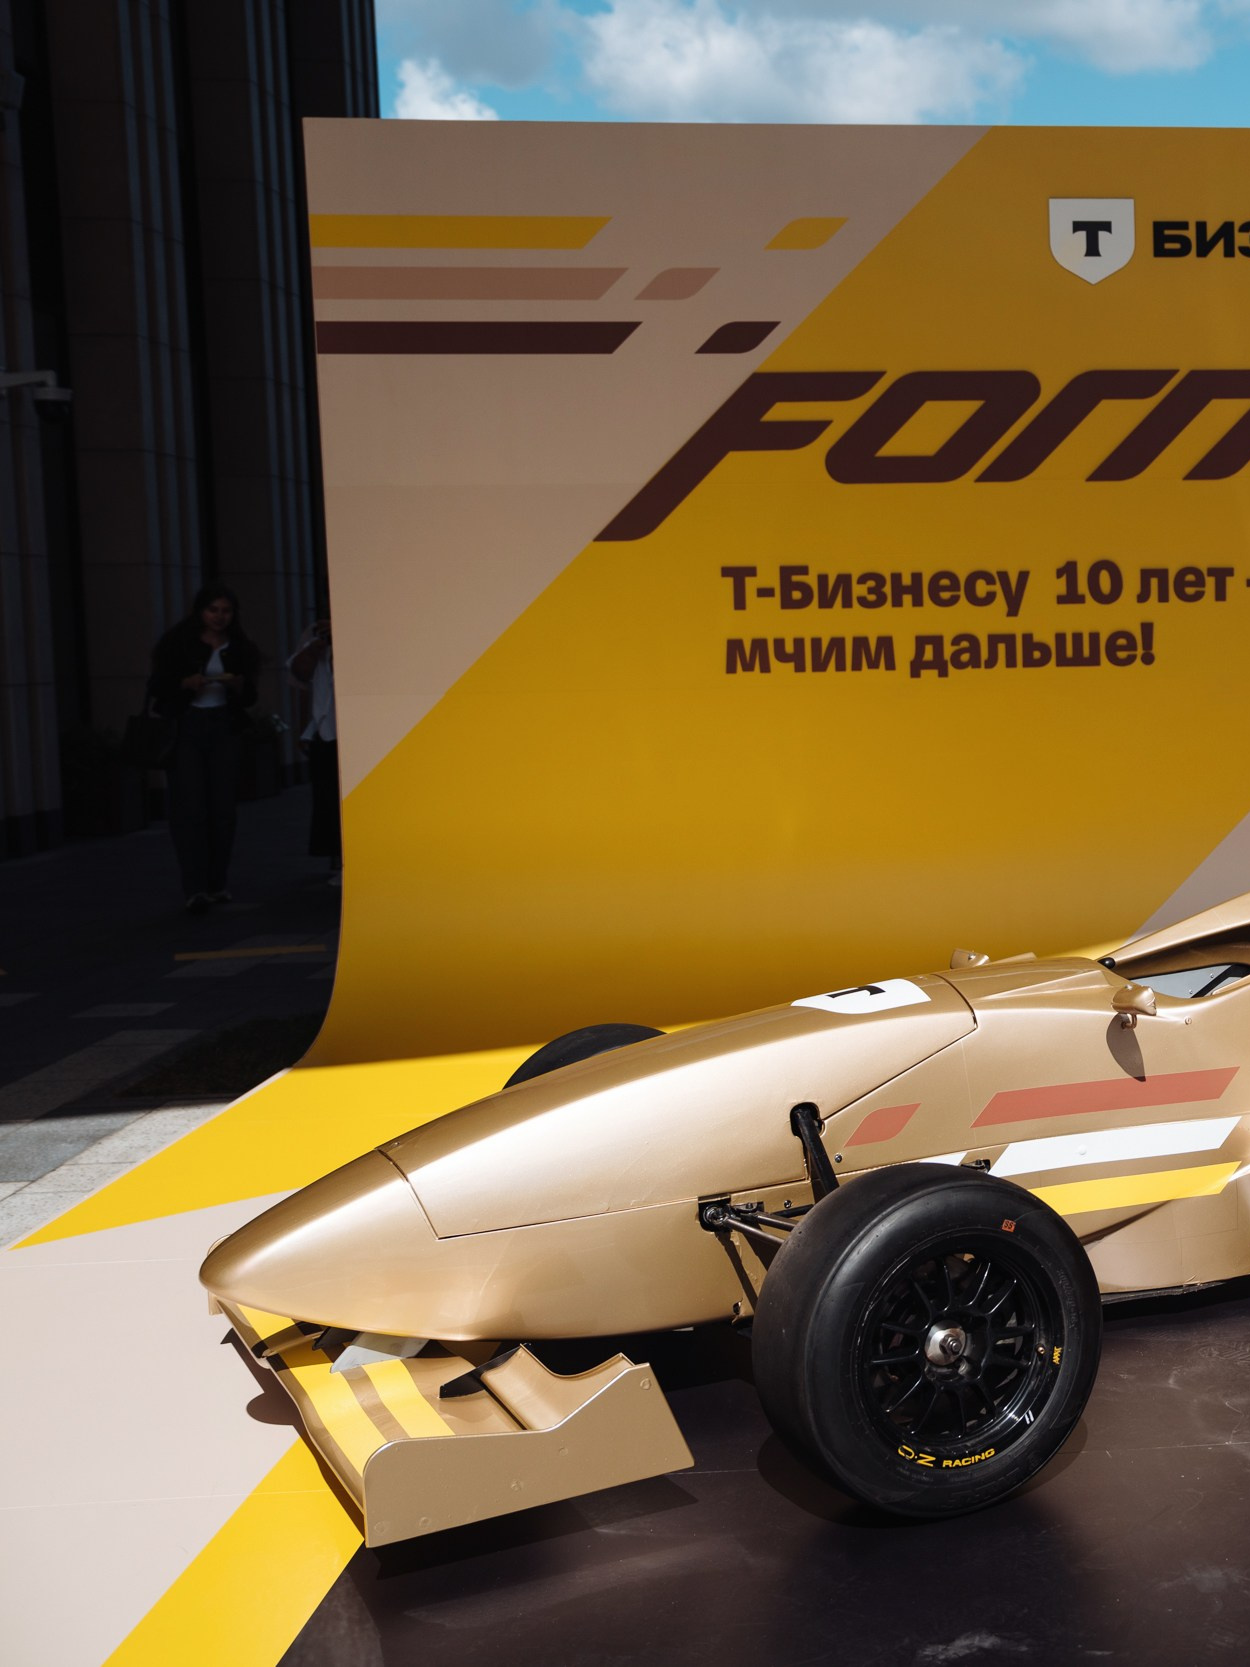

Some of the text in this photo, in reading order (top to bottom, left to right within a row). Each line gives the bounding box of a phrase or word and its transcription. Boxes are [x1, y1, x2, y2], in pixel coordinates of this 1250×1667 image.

[721, 564, 1031, 618] Т-Бизнесу
[1055, 559, 1124, 605] 10
[1136, 565, 1235, 604] лет
[725, 621, 1156, 679] мчим дальше!
[942, 1448, 996, 1468] RACING
